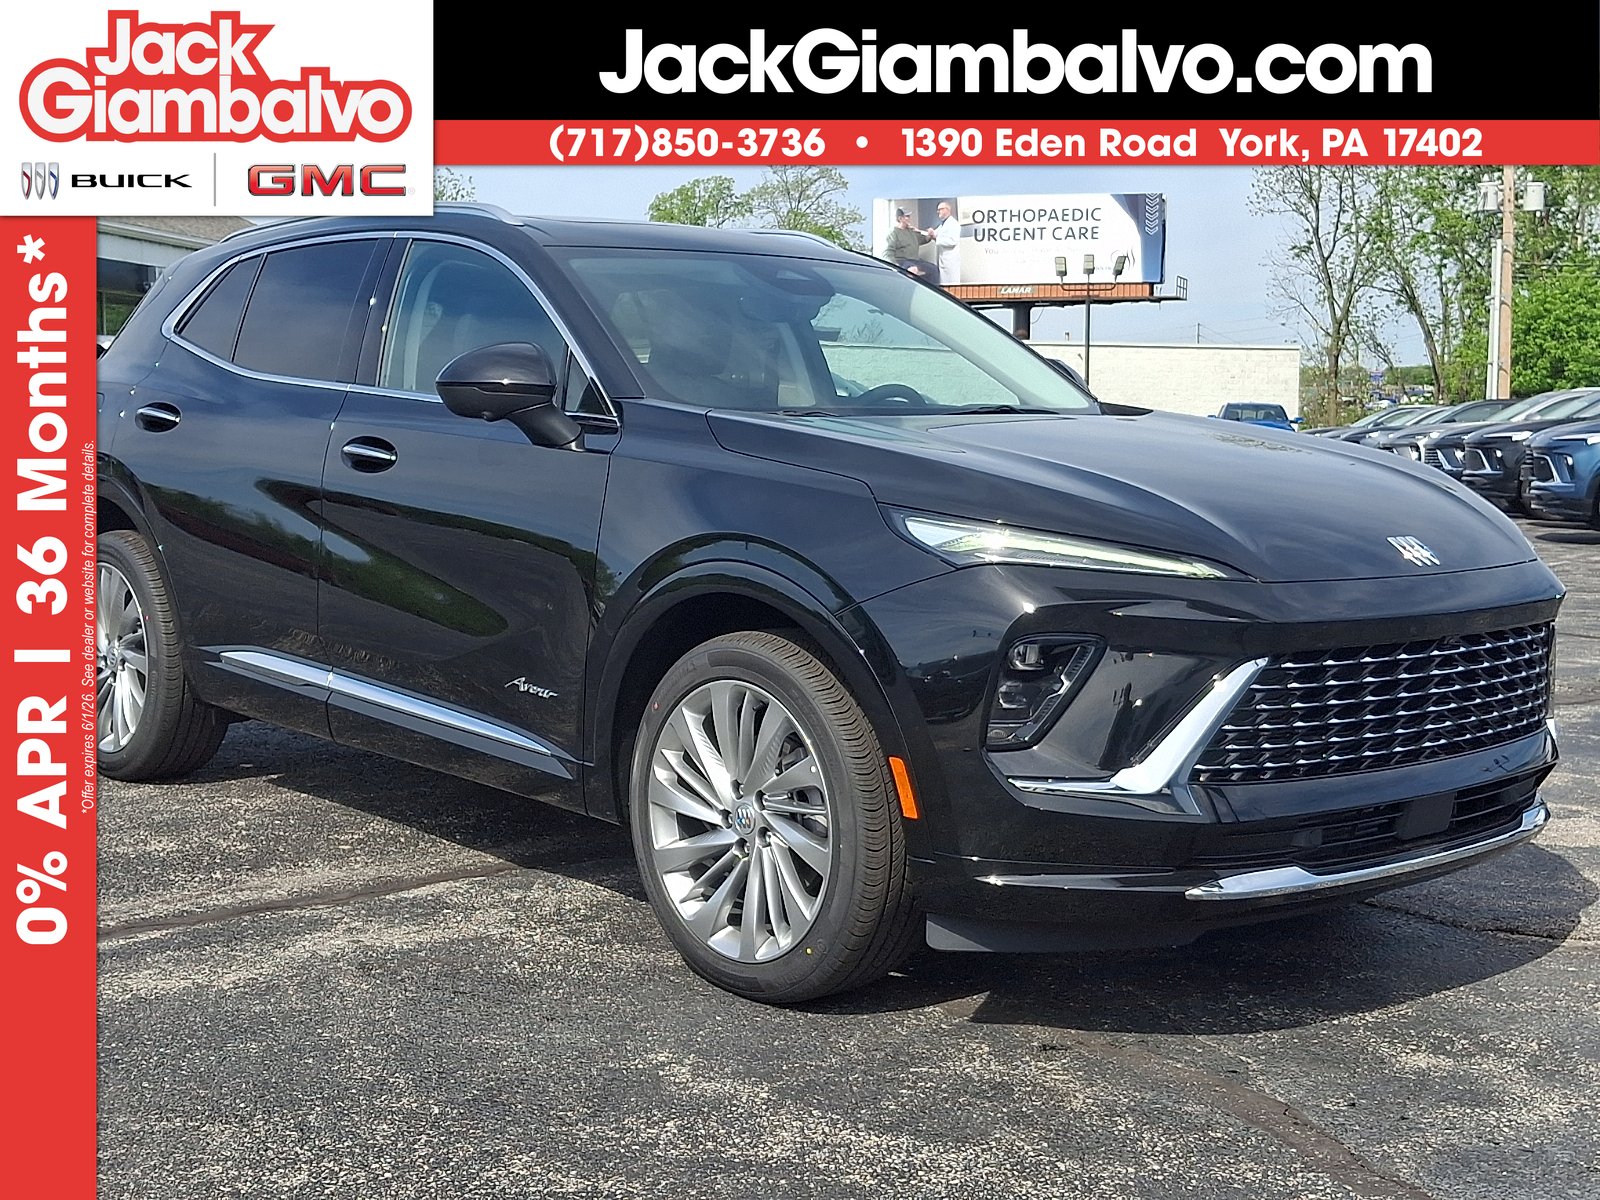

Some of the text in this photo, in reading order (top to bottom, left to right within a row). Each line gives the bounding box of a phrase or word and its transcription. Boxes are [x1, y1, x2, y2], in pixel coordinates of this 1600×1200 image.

[972, 207, 1101, 224] ORTHOPAEDIC
[974, 226, 1099, 242] URGENT CARE
[1000, 286, 1032, 294] LAMAR
